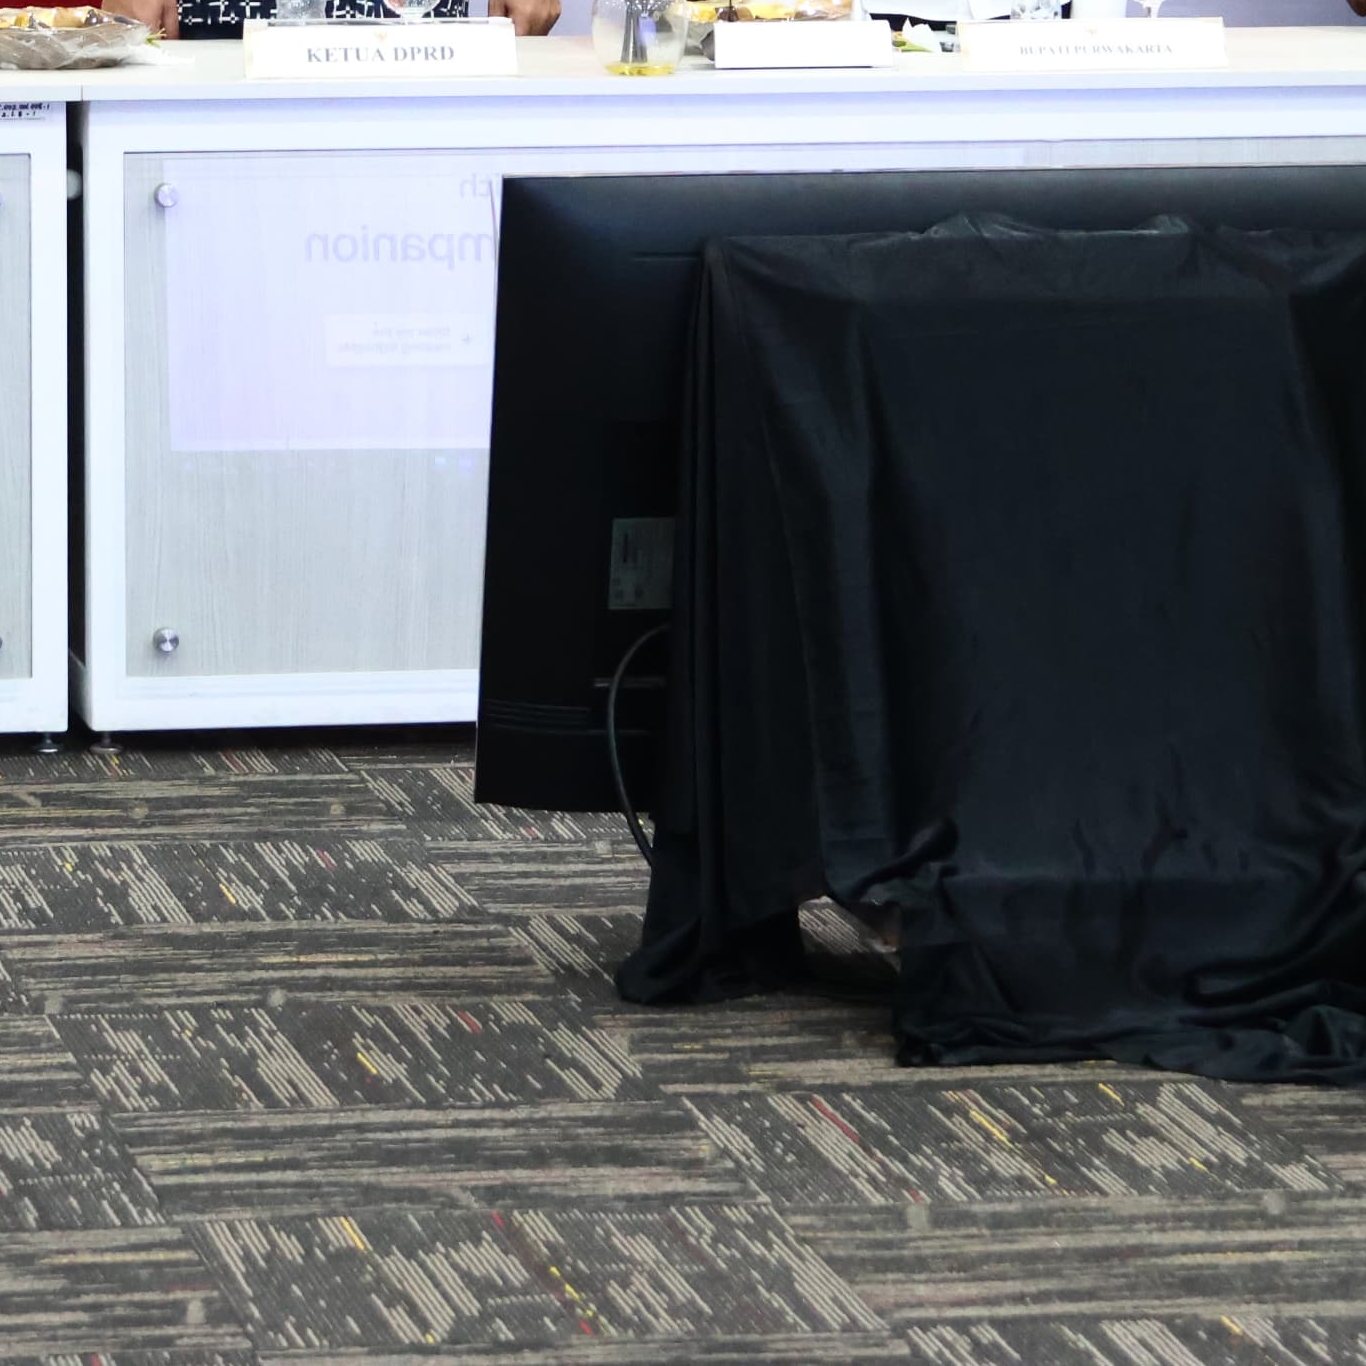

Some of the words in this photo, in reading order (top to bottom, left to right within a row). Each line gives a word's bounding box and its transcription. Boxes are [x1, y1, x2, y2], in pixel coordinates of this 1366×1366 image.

[306, 47, 386, 62] KETUA
[393, 46, 455, 61] DPRD
[1019, 45, 1070, 55] BUPATI
[1074, 44, 1173, 54] PURWAKARTA
